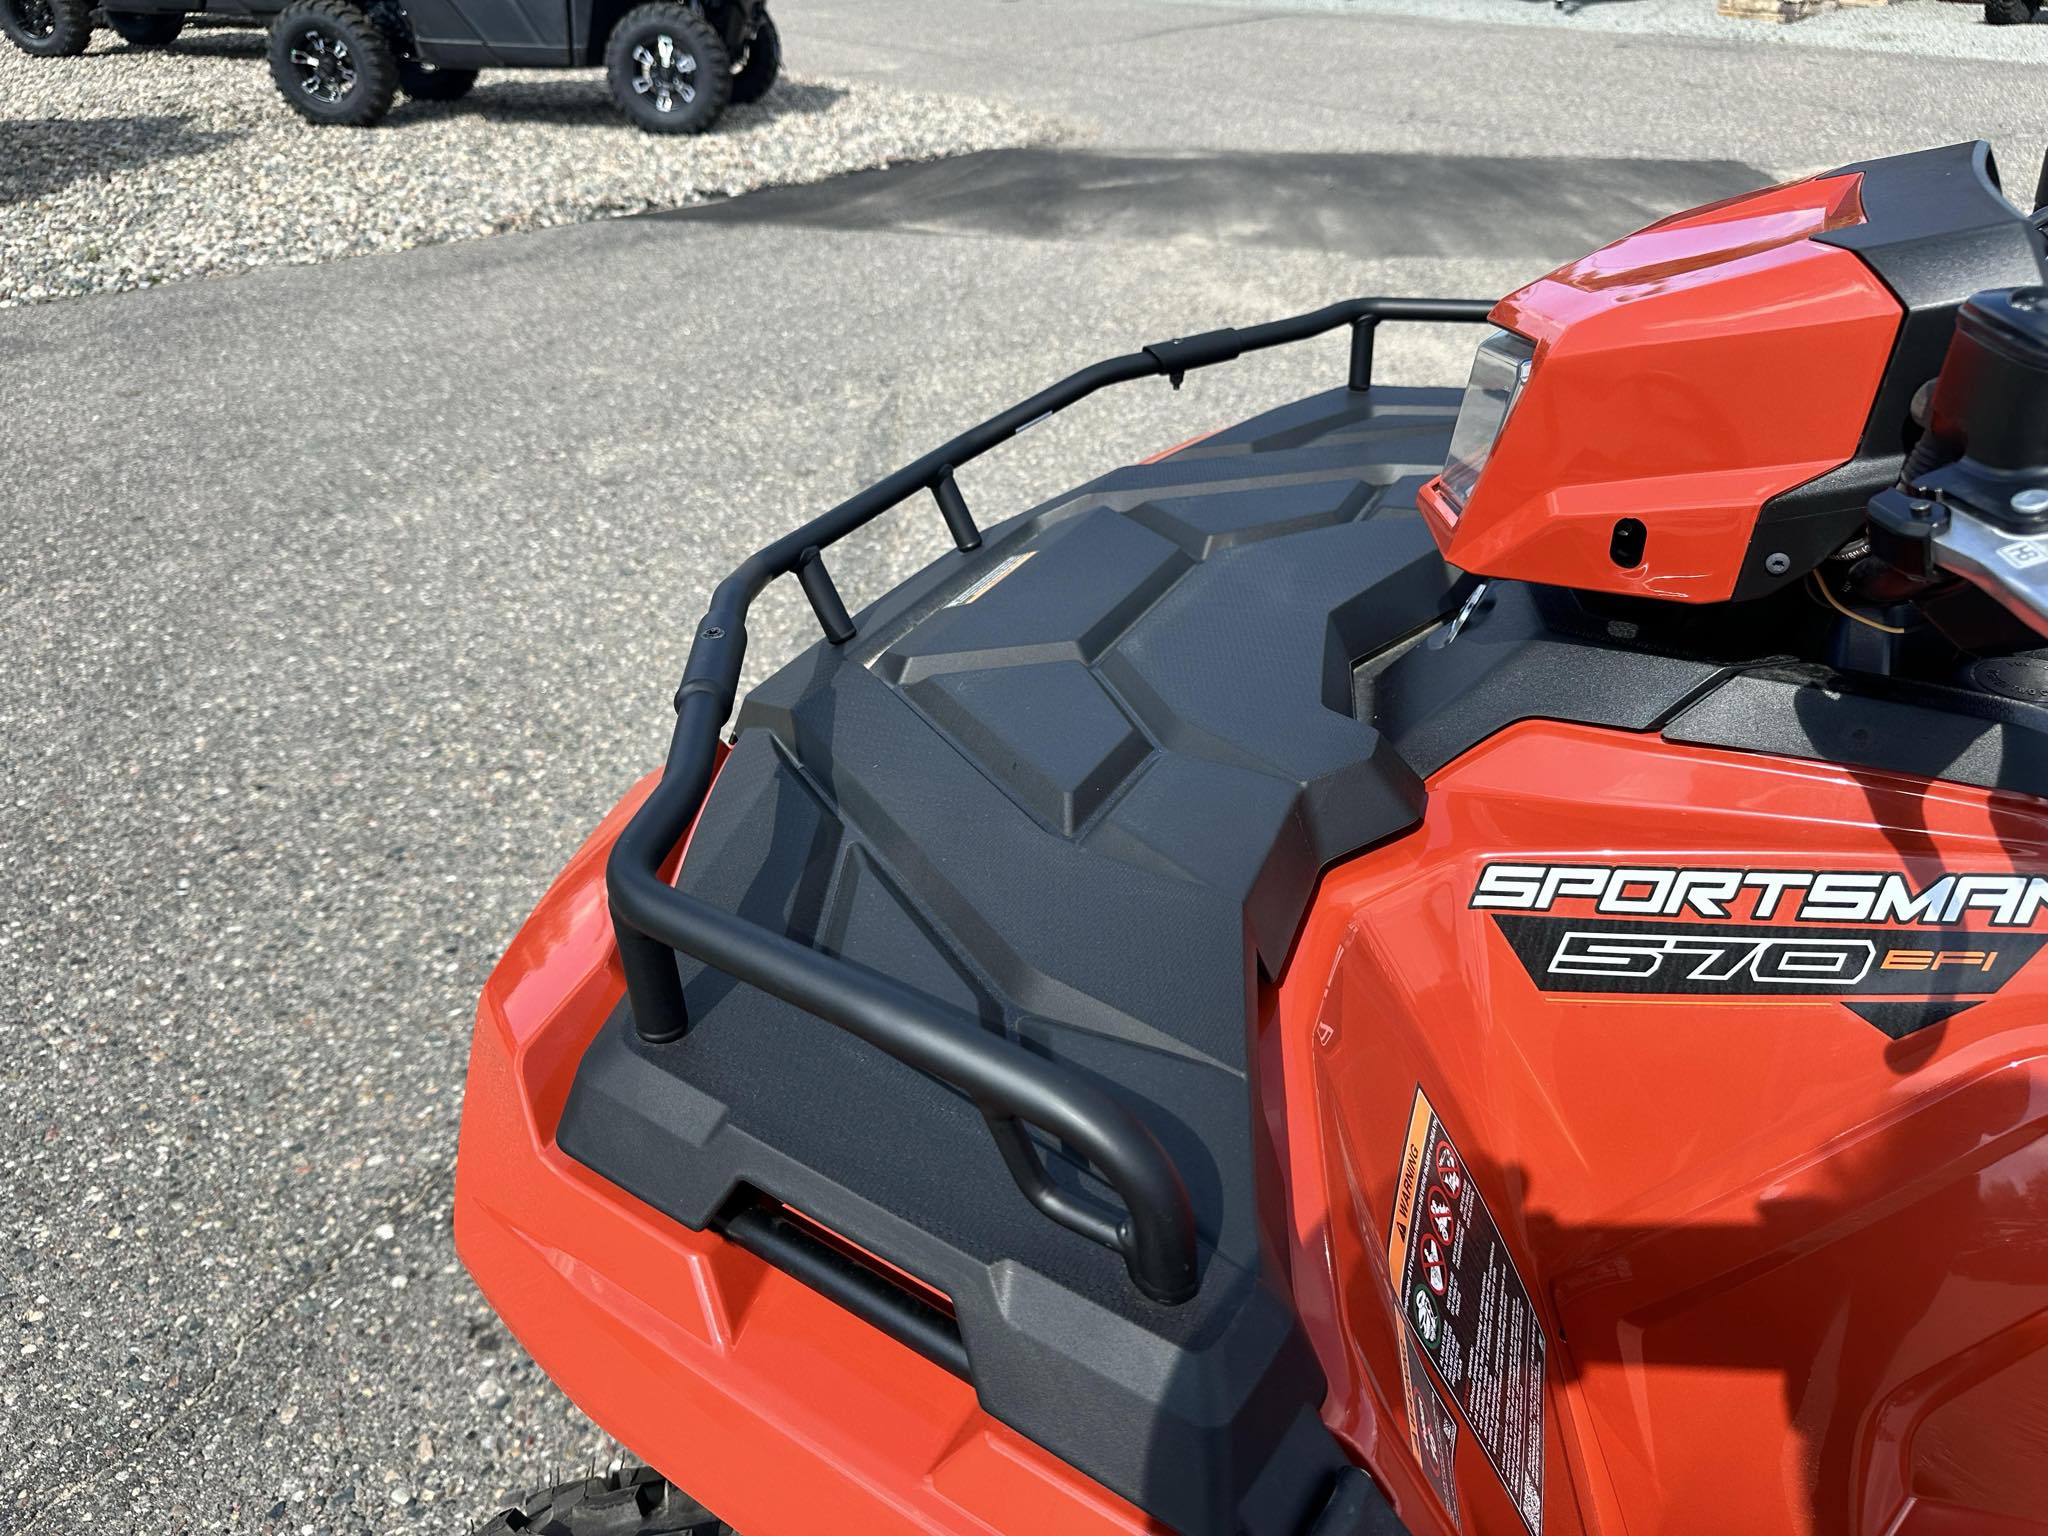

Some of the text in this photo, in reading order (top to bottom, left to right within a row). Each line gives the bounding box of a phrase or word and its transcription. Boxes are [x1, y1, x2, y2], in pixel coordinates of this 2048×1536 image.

[1547, 931, 1998, 985] 570 EFI
[1400, 1144, 1418, 1218] WARNING
